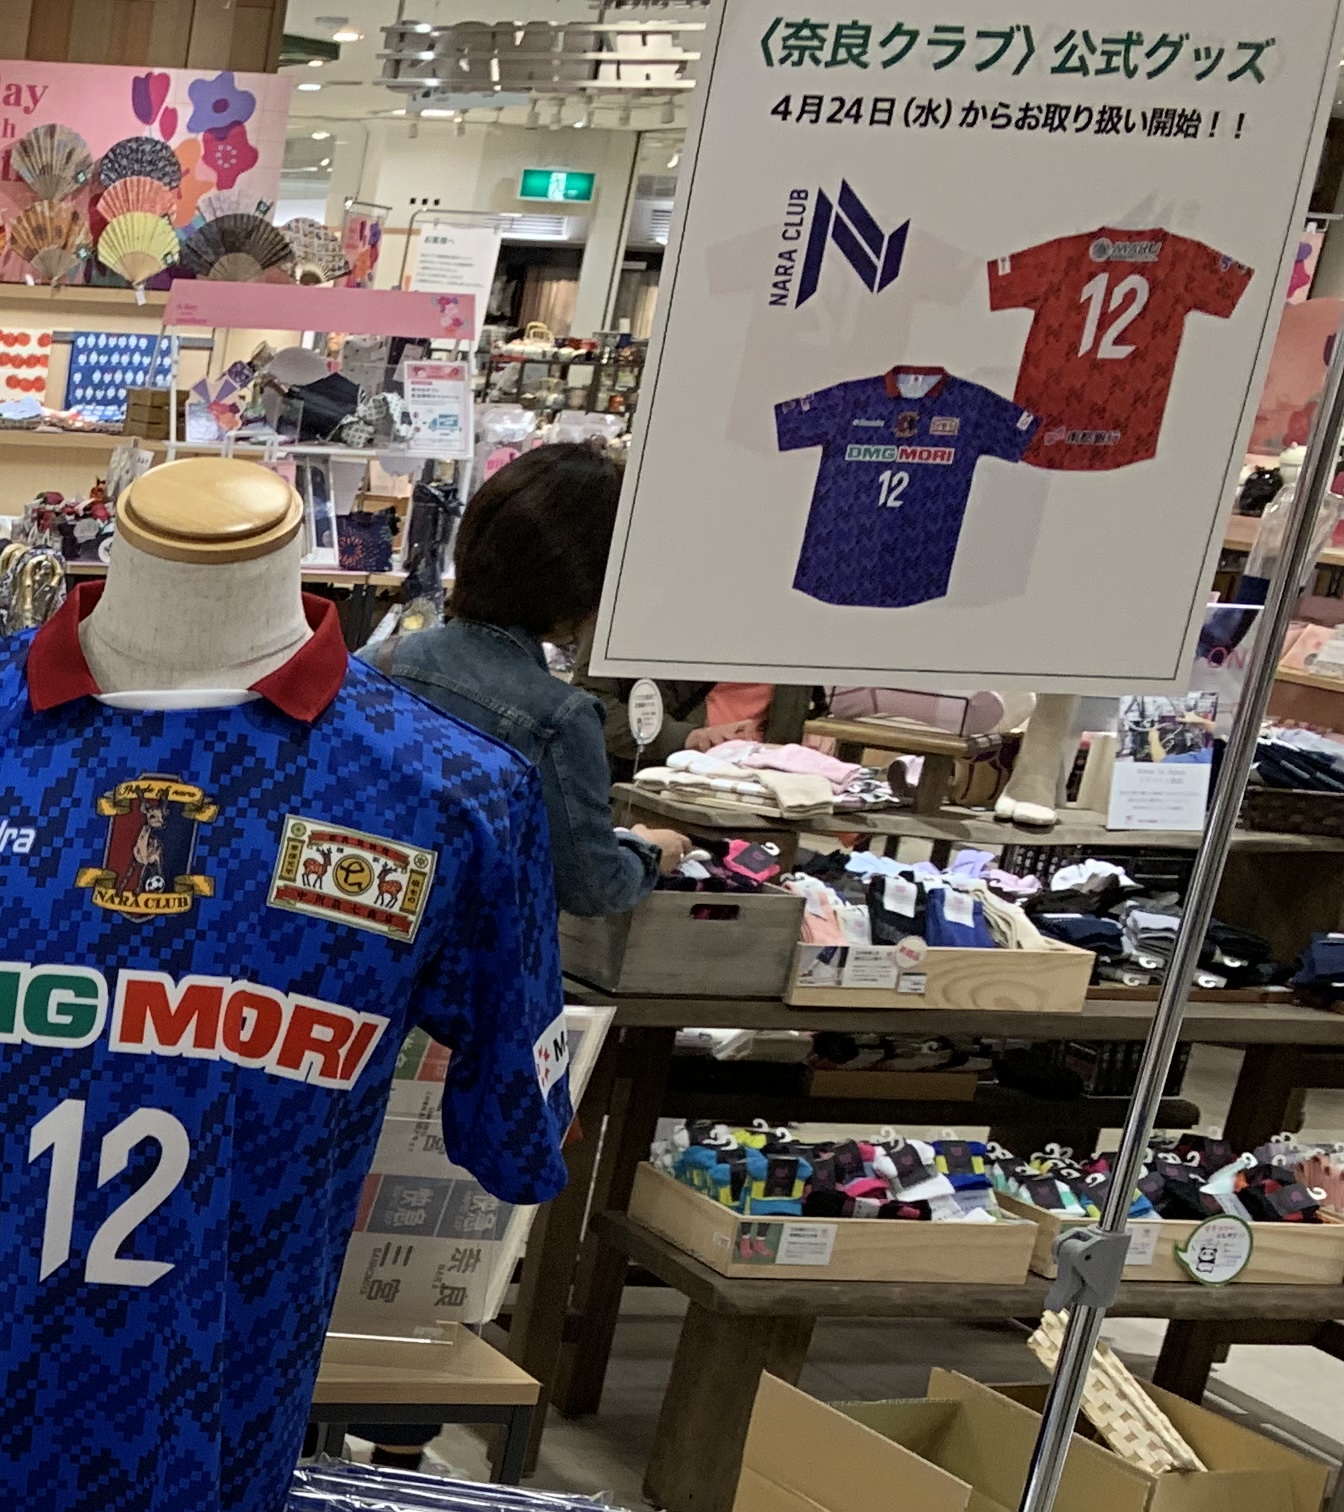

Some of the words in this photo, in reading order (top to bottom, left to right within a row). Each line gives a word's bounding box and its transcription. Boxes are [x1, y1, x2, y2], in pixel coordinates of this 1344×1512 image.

[1053, 28, 1276, 84] 公式グッズ
[782, 188, 808, 241] CLUB
[769, 248, 794, 307] NARA
[1077, 273, 1149, 359] 12
[845, 446, 897, 462] DMG
[898, 447, 954, 464] MORI
[877, 470, 909, 507] 12
[95, 889, 139, 911] NARA
[143, 892, 190, 911] CLUB
[119, 976, 379, 1083] MORI
[28, 1098, 191, 1288] 12
